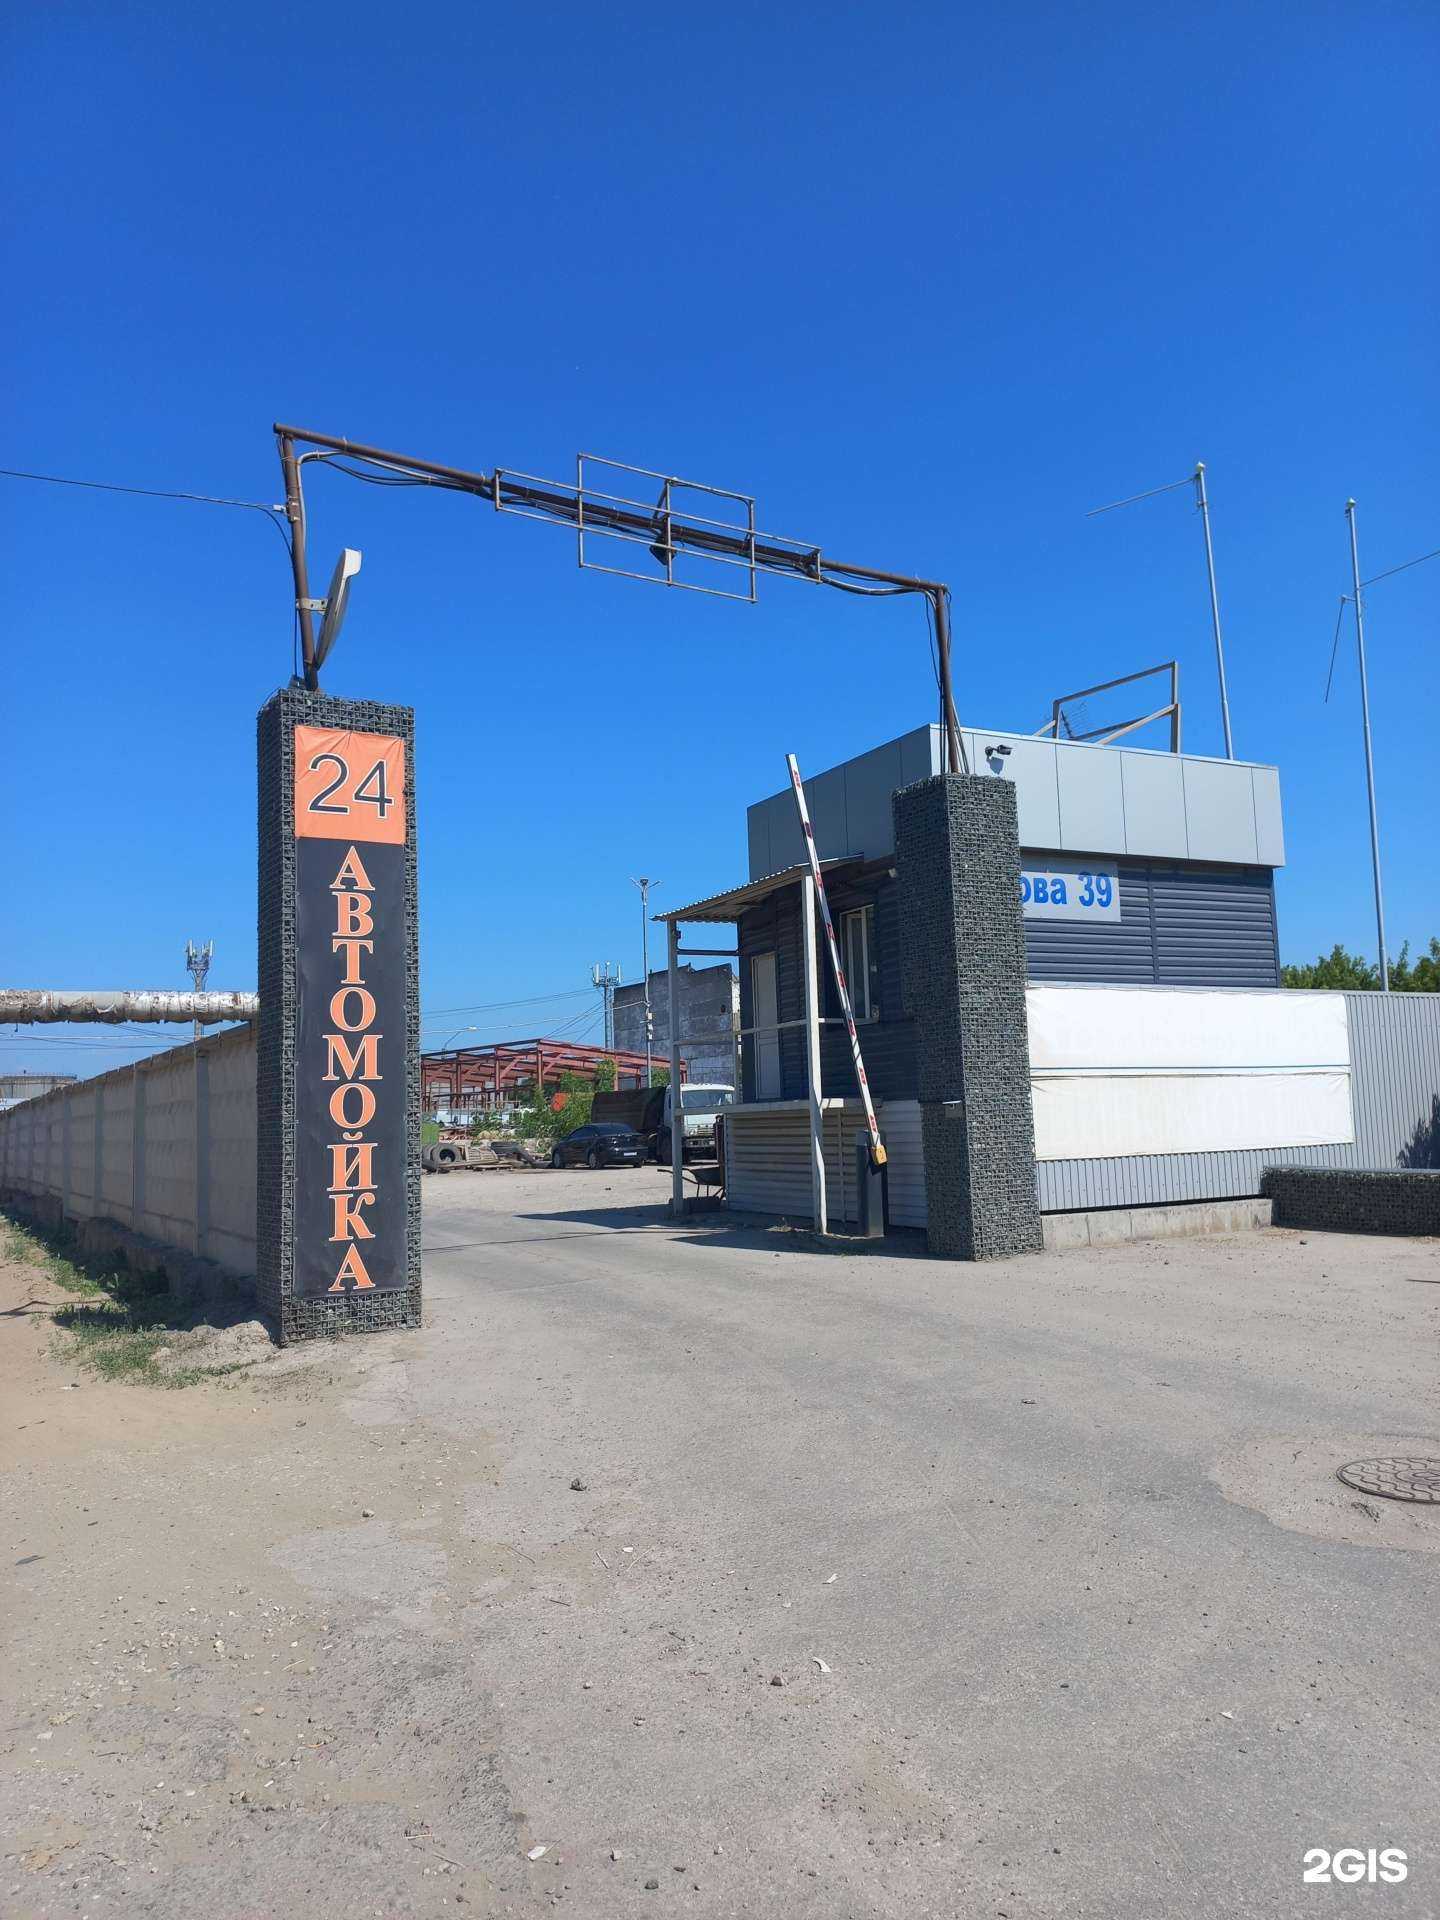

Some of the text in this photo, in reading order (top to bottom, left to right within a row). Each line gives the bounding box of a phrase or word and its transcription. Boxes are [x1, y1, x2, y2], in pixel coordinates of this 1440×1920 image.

[308, 752, 394, 819] 24
[1078, 871, 1112, 908] 39
[321, 845, 383, 1293] АВТОМОЙКА
